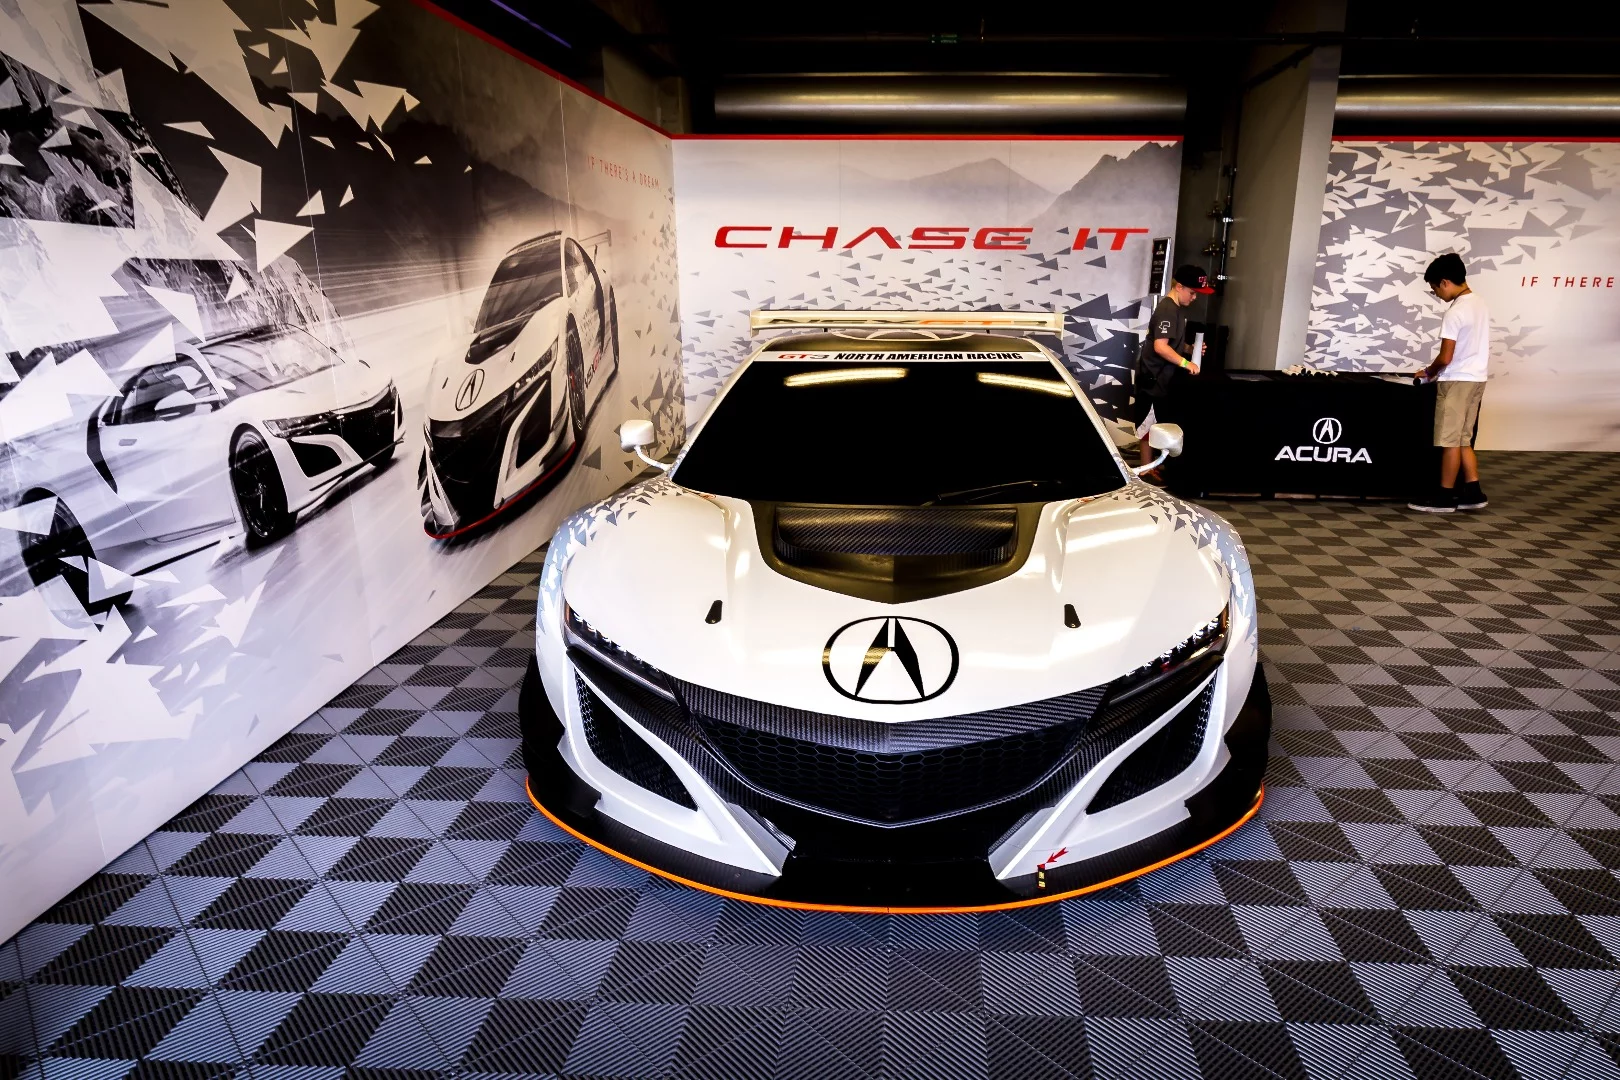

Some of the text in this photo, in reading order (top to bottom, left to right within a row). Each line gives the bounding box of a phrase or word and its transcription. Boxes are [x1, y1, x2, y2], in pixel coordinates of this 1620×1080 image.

[714, 226, 1149, 251] CHASE IT
[1521, 276, 1614, 288] IF THERE
[834, 352, 885, 360] NORTH
[966, 352, 1023, 360] RACING
[1274, 445, 1372, 463] ACURA
